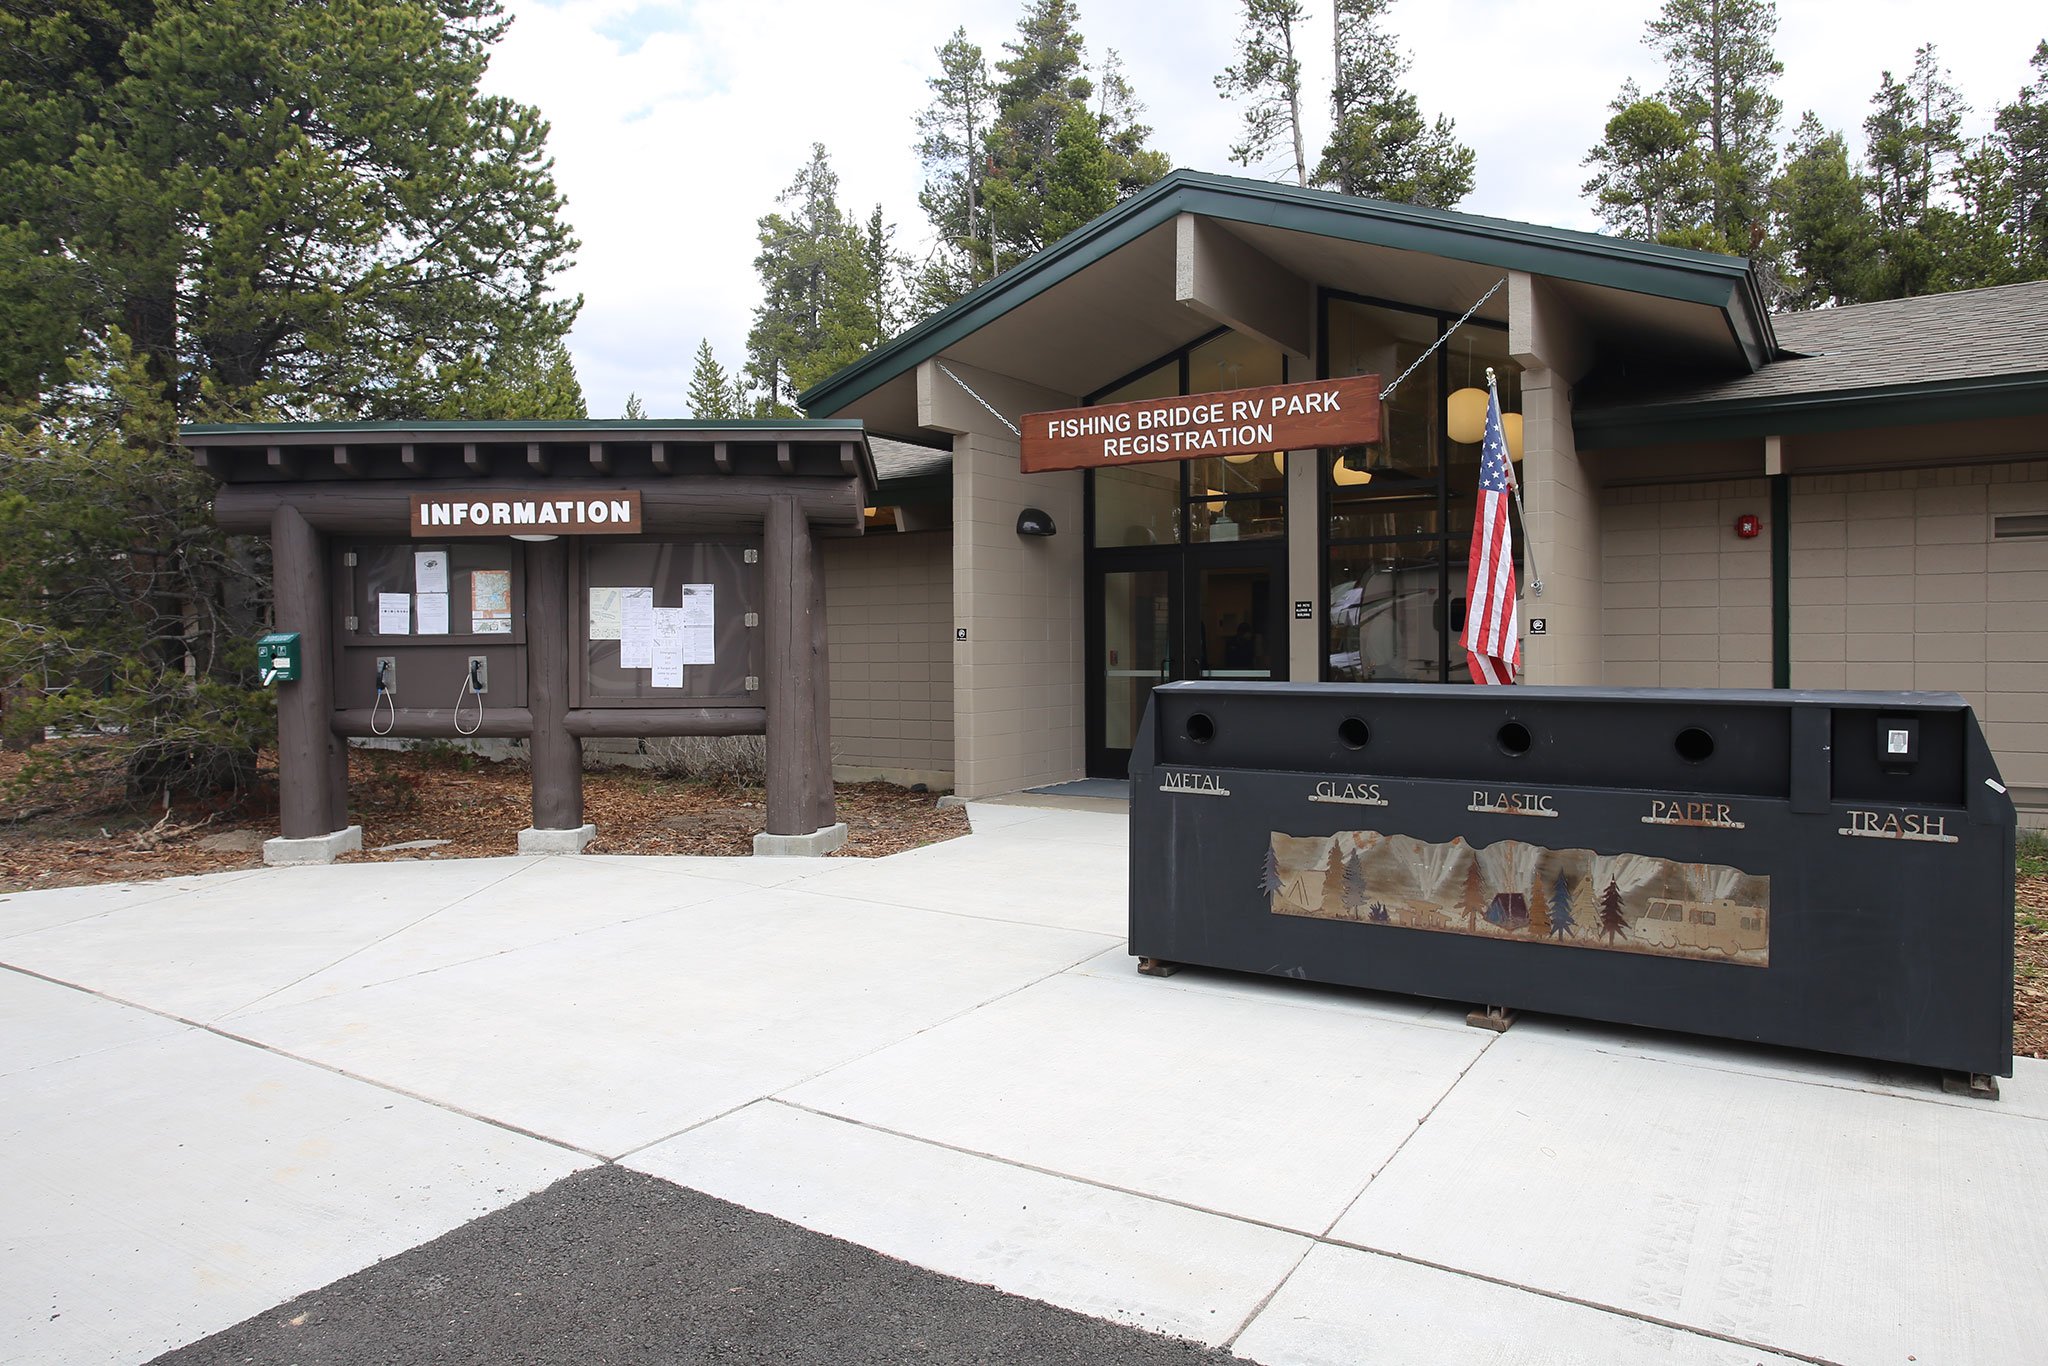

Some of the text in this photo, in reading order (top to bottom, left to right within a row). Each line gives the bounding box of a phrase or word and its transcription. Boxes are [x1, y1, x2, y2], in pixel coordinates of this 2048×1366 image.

[1048, 390, 1341, 439] FISHING BRIDGE RV PARK
[1103, 423, 1274, 458] REGISTRATION
[420, 500, 631, 526] INFORMATION
[1164, 772, 1226, 791] METAL
[1315, 781, 1381, 801] GLASS
[1472, 791, 1554, 812] PLASTIC
[1652, 800, 1733, 823] PAPER
[1846, 810, 1946, 837] TRASH
